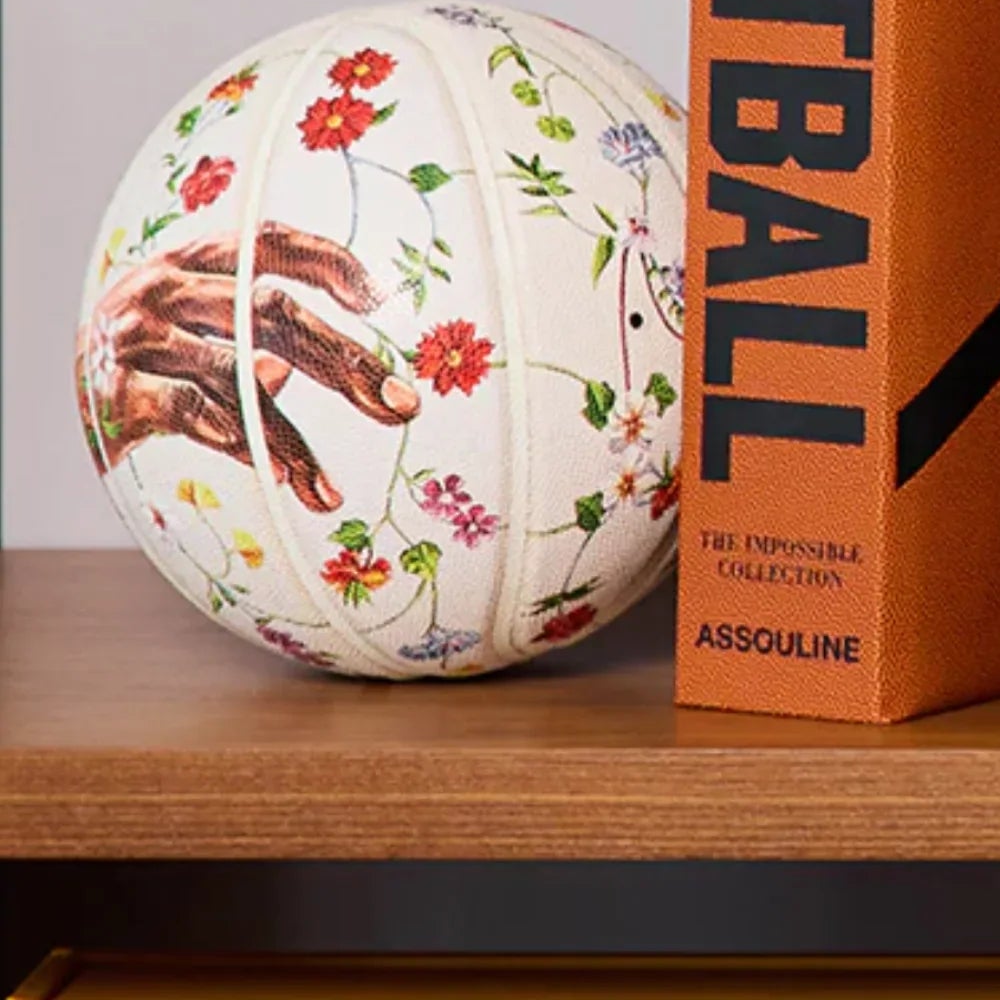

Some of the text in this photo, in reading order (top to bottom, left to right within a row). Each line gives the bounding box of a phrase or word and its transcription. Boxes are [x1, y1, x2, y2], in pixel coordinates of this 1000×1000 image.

[701, 530, 864, 564] THE IMPOSSIBLE
[717, 559, 843, 588] COLLECTION
[695, 623, 860, 663] ASSOULINE
